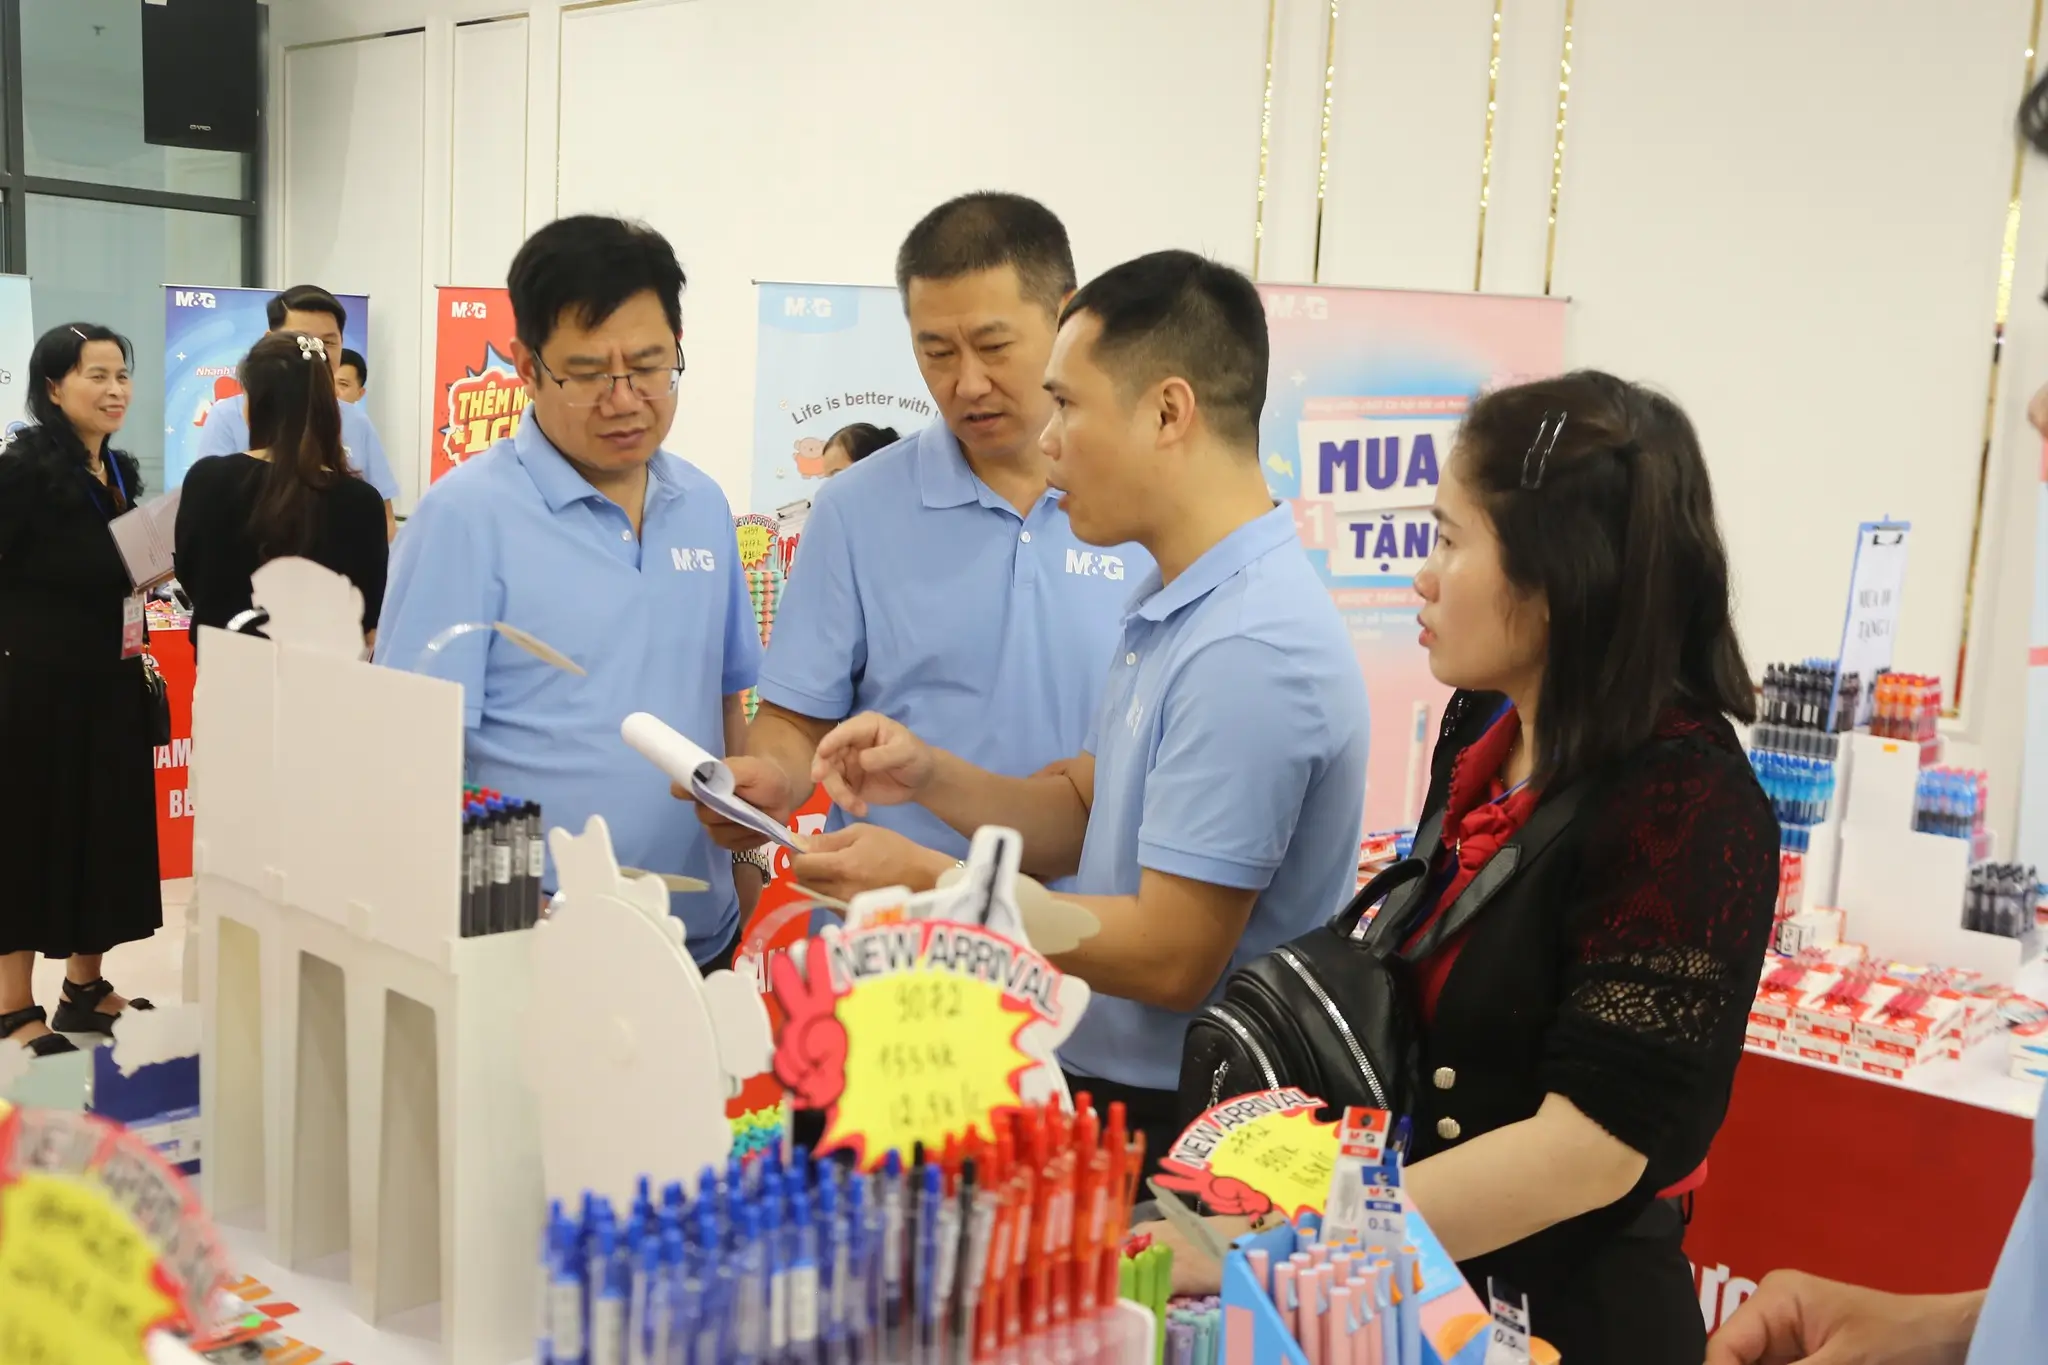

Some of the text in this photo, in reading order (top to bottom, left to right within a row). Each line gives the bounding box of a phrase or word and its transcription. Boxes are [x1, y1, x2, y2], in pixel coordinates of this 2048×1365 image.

[176, 291, 216, 308] M&G
[452, 301, 487, 319] M&G
[785, 297, 832, 317] M&G
[458, 381, 510, 420] THÊM
[792, 392, 930, 424] Life is better with
[1319, 434, 1440, 494] MUA
[1349, 514, 1439, 572] TẶN
[671, 547, 715, 572] M&G
[1066, 548, 1125, 580] M&G
[833, 928, 921, 988] NEW
[927, 929, 1061, 1018] ARRIVAL
[1174, 1121, 1225, 1169] NEW
[1213, 1089, 1319, 1132] ARRIVAL
